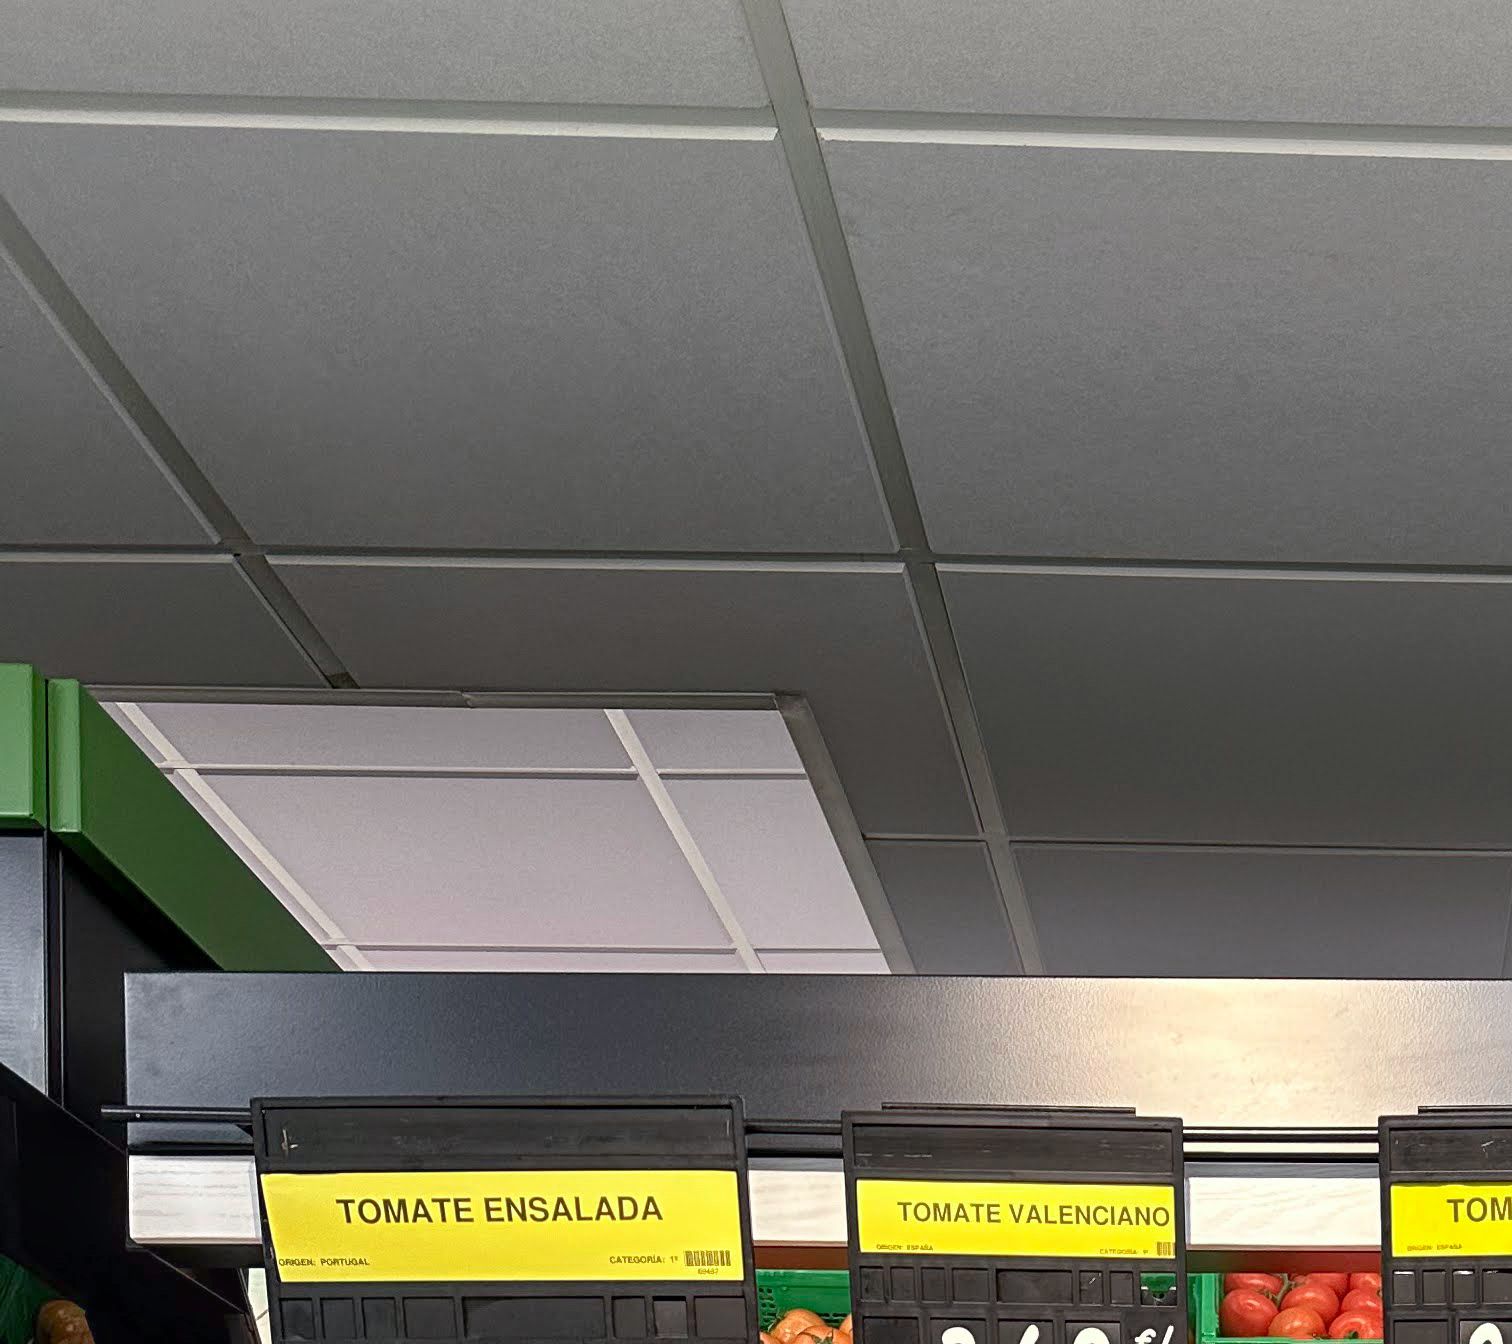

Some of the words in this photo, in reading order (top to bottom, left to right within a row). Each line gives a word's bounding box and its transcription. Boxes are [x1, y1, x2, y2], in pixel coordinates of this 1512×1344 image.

[335, 1197, 474, 1225] TOMATE
[483, 1195, 663, 1222] ENSALADA
[897, 1200, 1001, 1223] TOMATE
[1009, 1203, 1170, 1227] VALENCIANO
[320, 1257, 370, 1266] PORTUGAL
